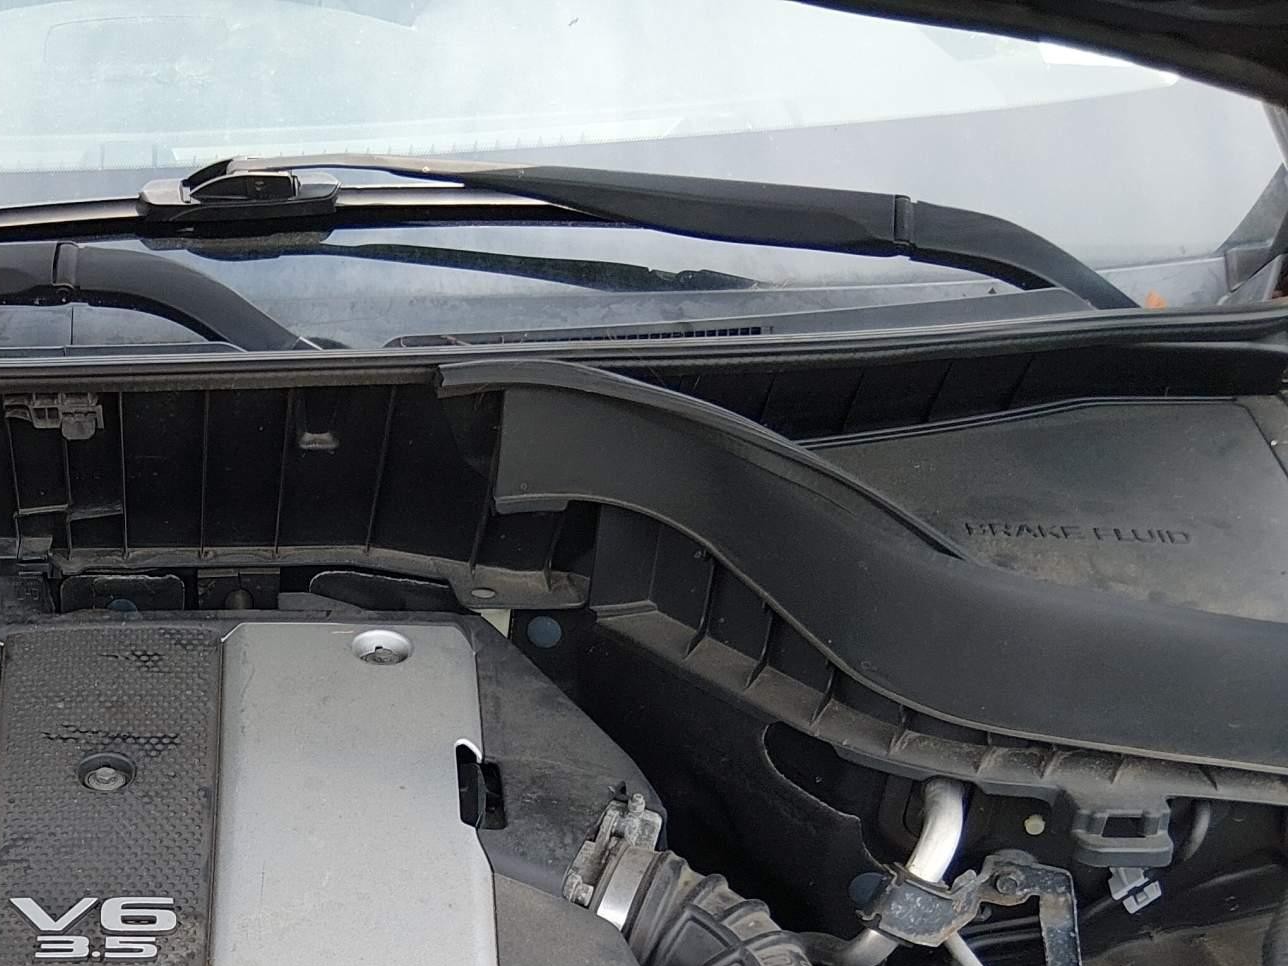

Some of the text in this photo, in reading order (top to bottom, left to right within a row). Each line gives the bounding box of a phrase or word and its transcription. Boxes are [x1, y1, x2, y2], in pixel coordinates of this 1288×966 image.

[964, 522, 1192, 545] BRAKE FLUID
[9, 896, 177, 932] V6
[34, 935, 158, 959] 3.5
